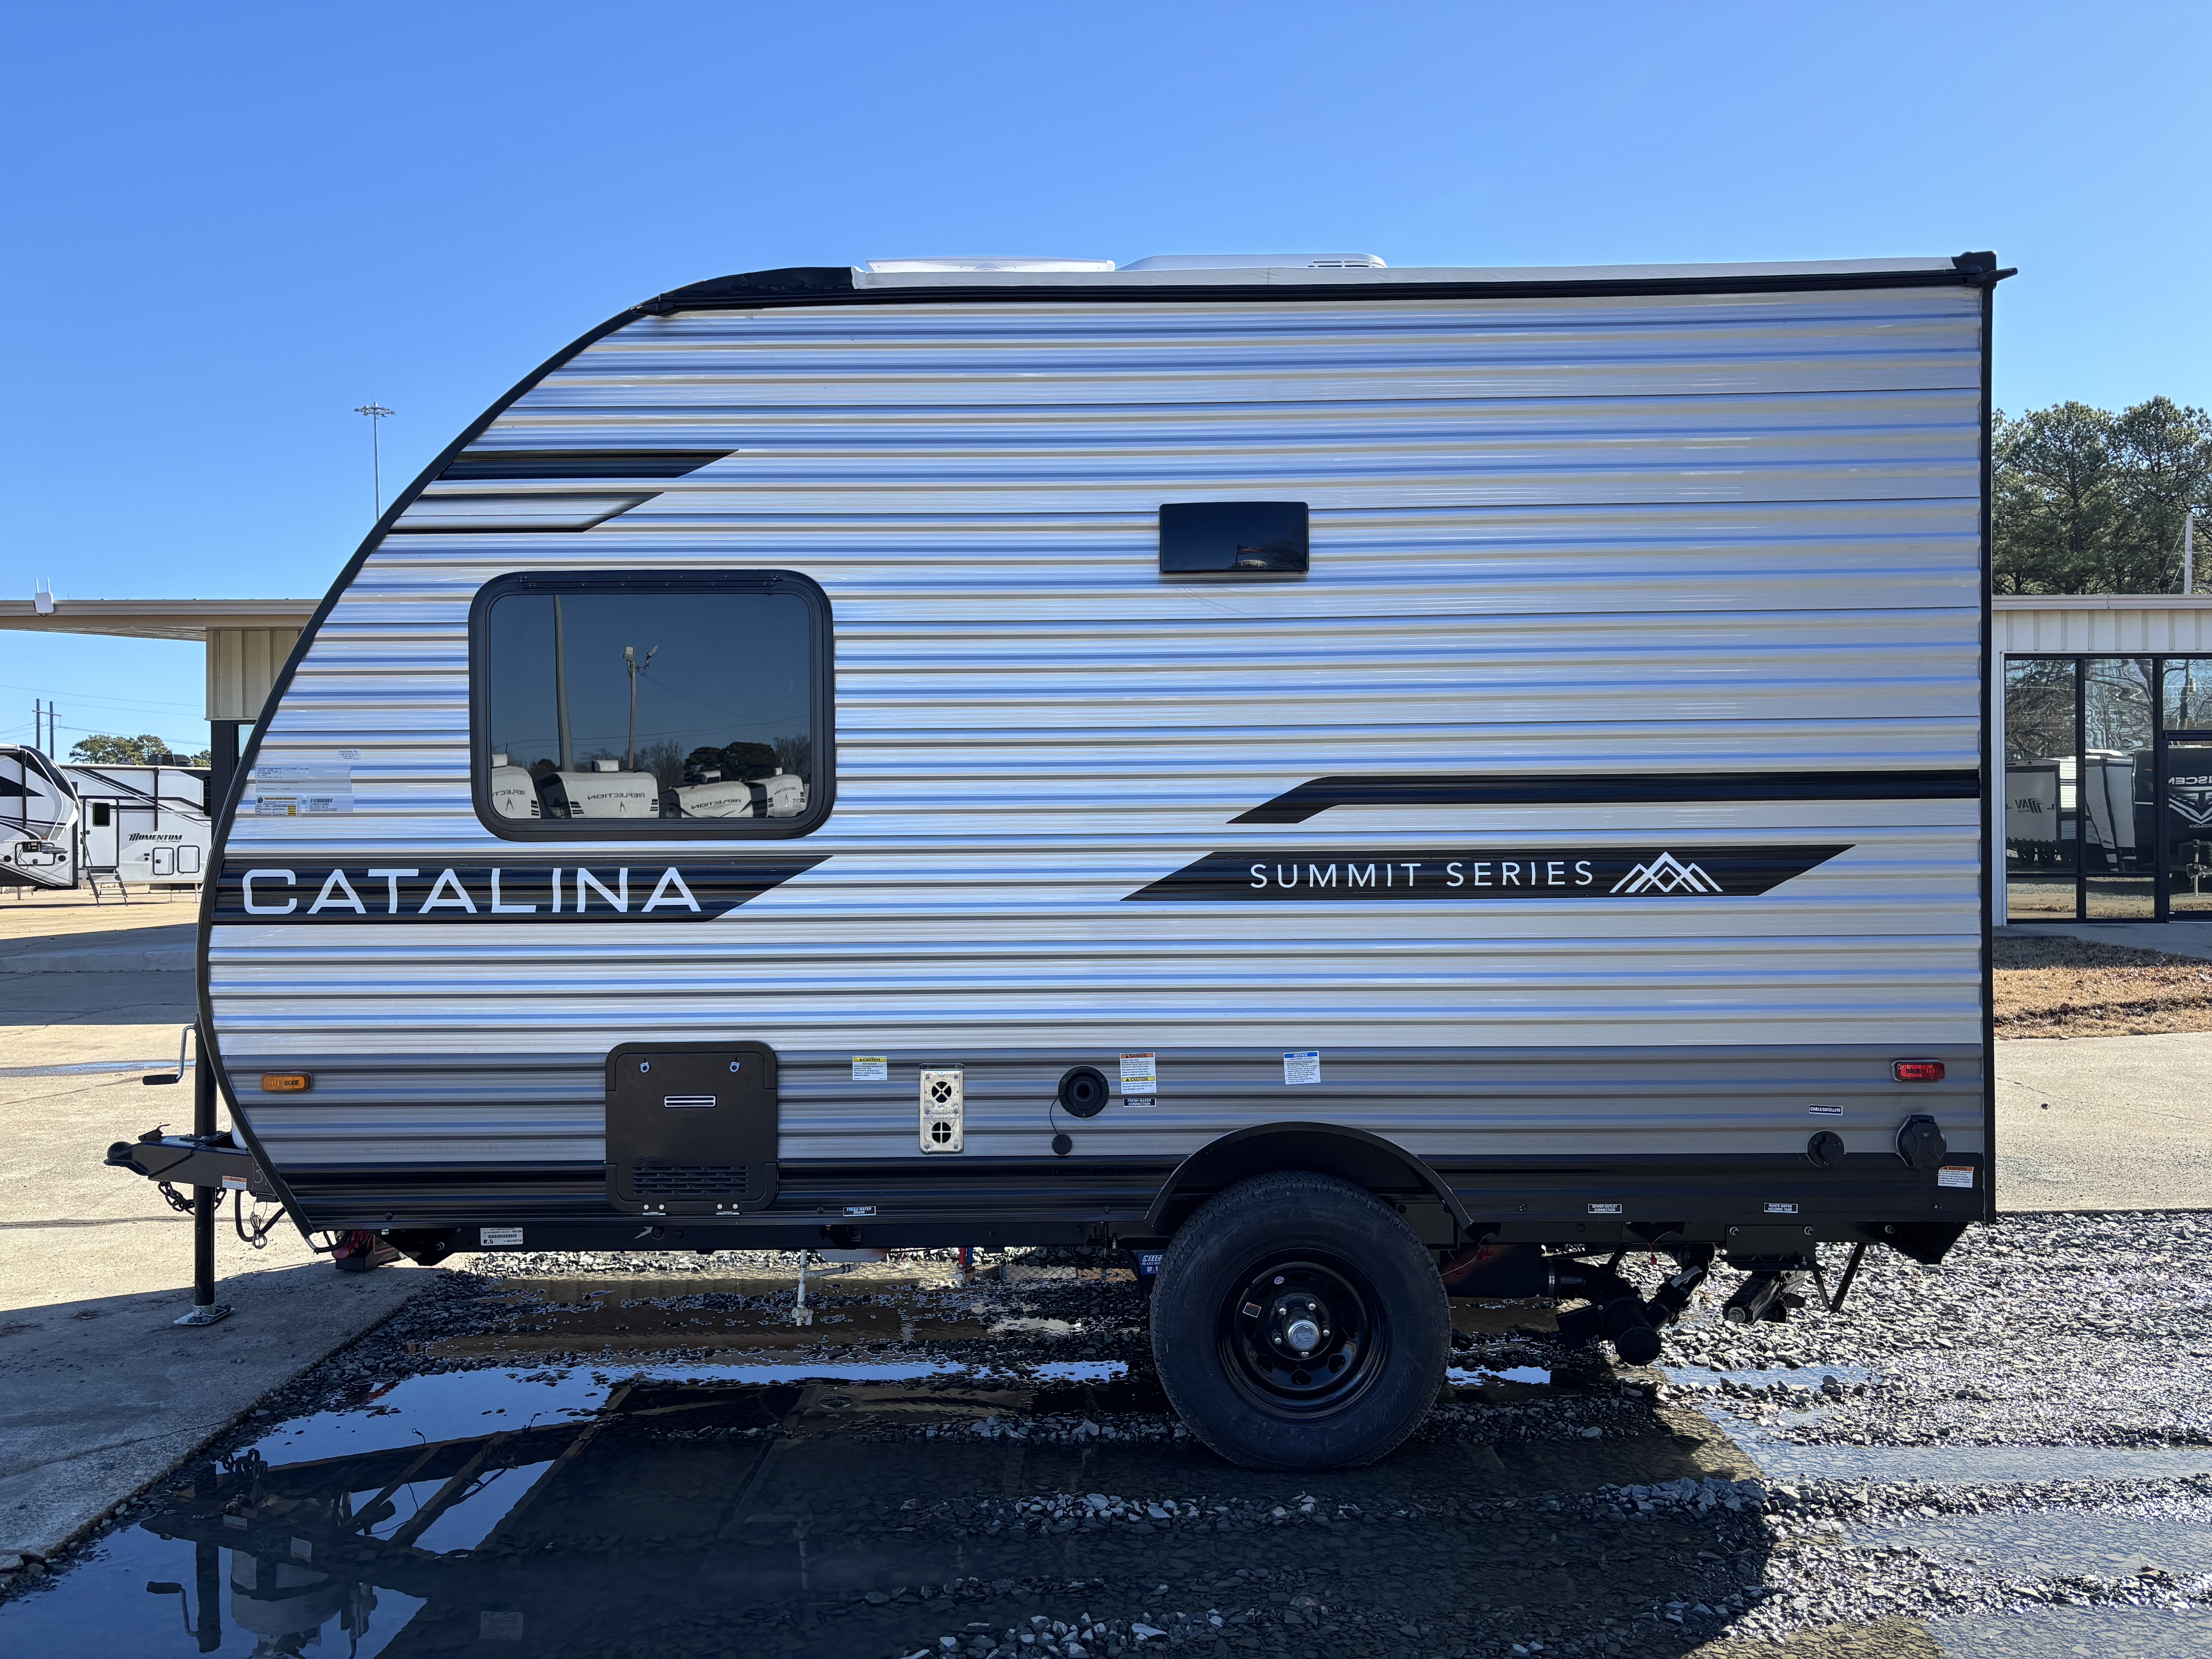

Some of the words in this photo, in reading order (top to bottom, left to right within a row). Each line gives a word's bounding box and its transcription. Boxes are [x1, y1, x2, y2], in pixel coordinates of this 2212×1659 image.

[242, 867, 702, 914] CATALINA
[1250, 862, 1421, 888] SUMMIT
[1446, 860, 1593, 887] SERIES
